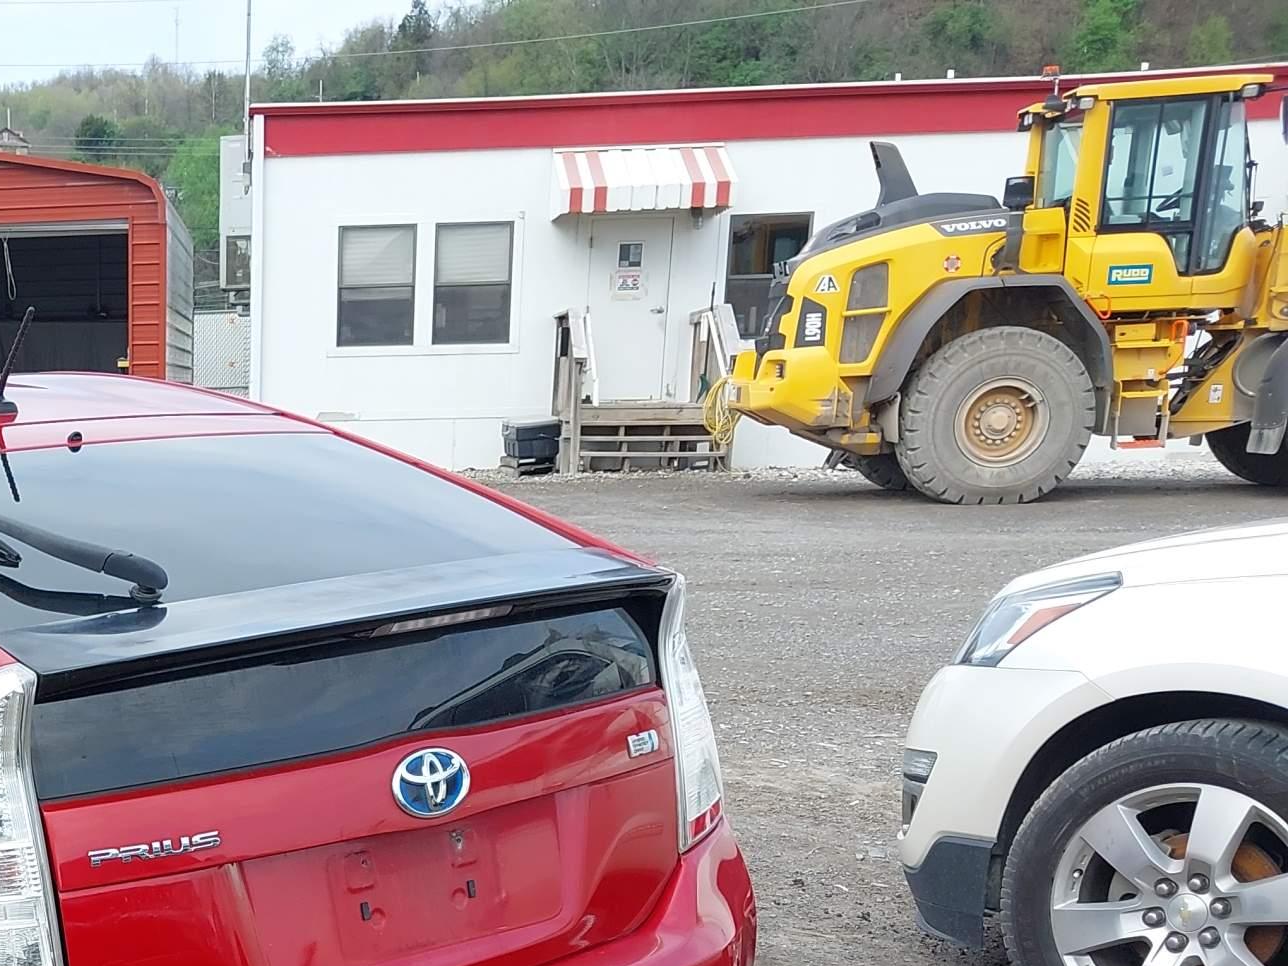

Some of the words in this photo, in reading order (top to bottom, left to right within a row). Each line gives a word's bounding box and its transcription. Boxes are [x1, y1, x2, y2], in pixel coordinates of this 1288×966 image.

[940, 218, 1007, 233] VOLVO
[1111, 268, 1150, 282] RUDD
[804, 312, 823, 342] L90H
[87, 830, 222, 867] PRIUS
